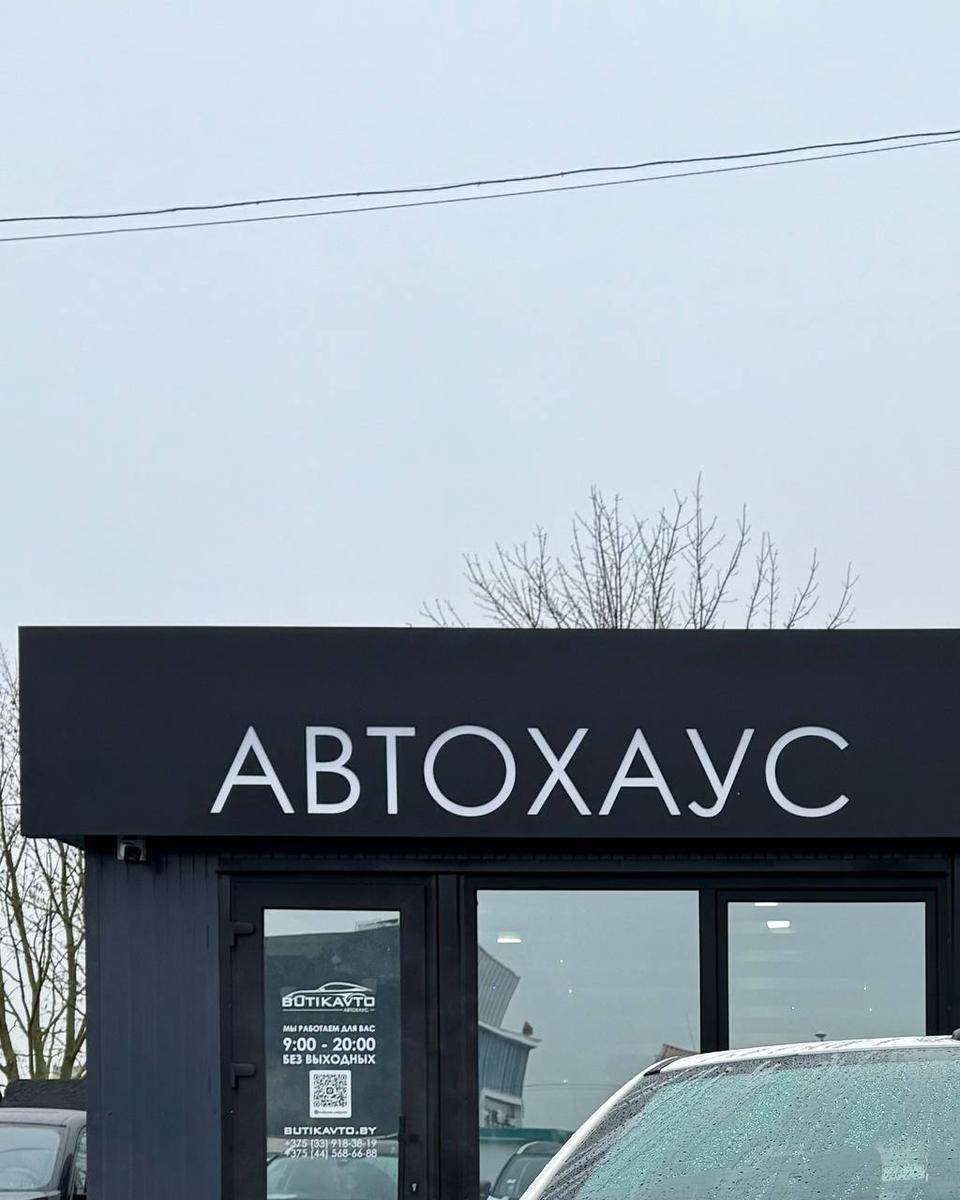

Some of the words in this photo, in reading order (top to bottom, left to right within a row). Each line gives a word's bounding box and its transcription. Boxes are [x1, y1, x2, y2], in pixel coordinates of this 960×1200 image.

[210, 725, 850, 818] АВТОХАУС
[282, 996, 376, 1008] BUTIKAVTO
[341, 1025, 357, 1033] ДЛЯ
[283, 1037, 316, 1051] 9:00
[332, 1037, 376, 1051] 20:00
[283, 1054, 302, 1065] БЕЗ
[305, 1053, 376, 1066] ВЫХОДНЫХ
[284, 1126, 377, 1135] BUTIKAVTO.BY
[285, 1139, 308, 1148] +375
[311, 1139, 328, 1149] (33)
[330, 1139, 377, 1148] 918-38-19
